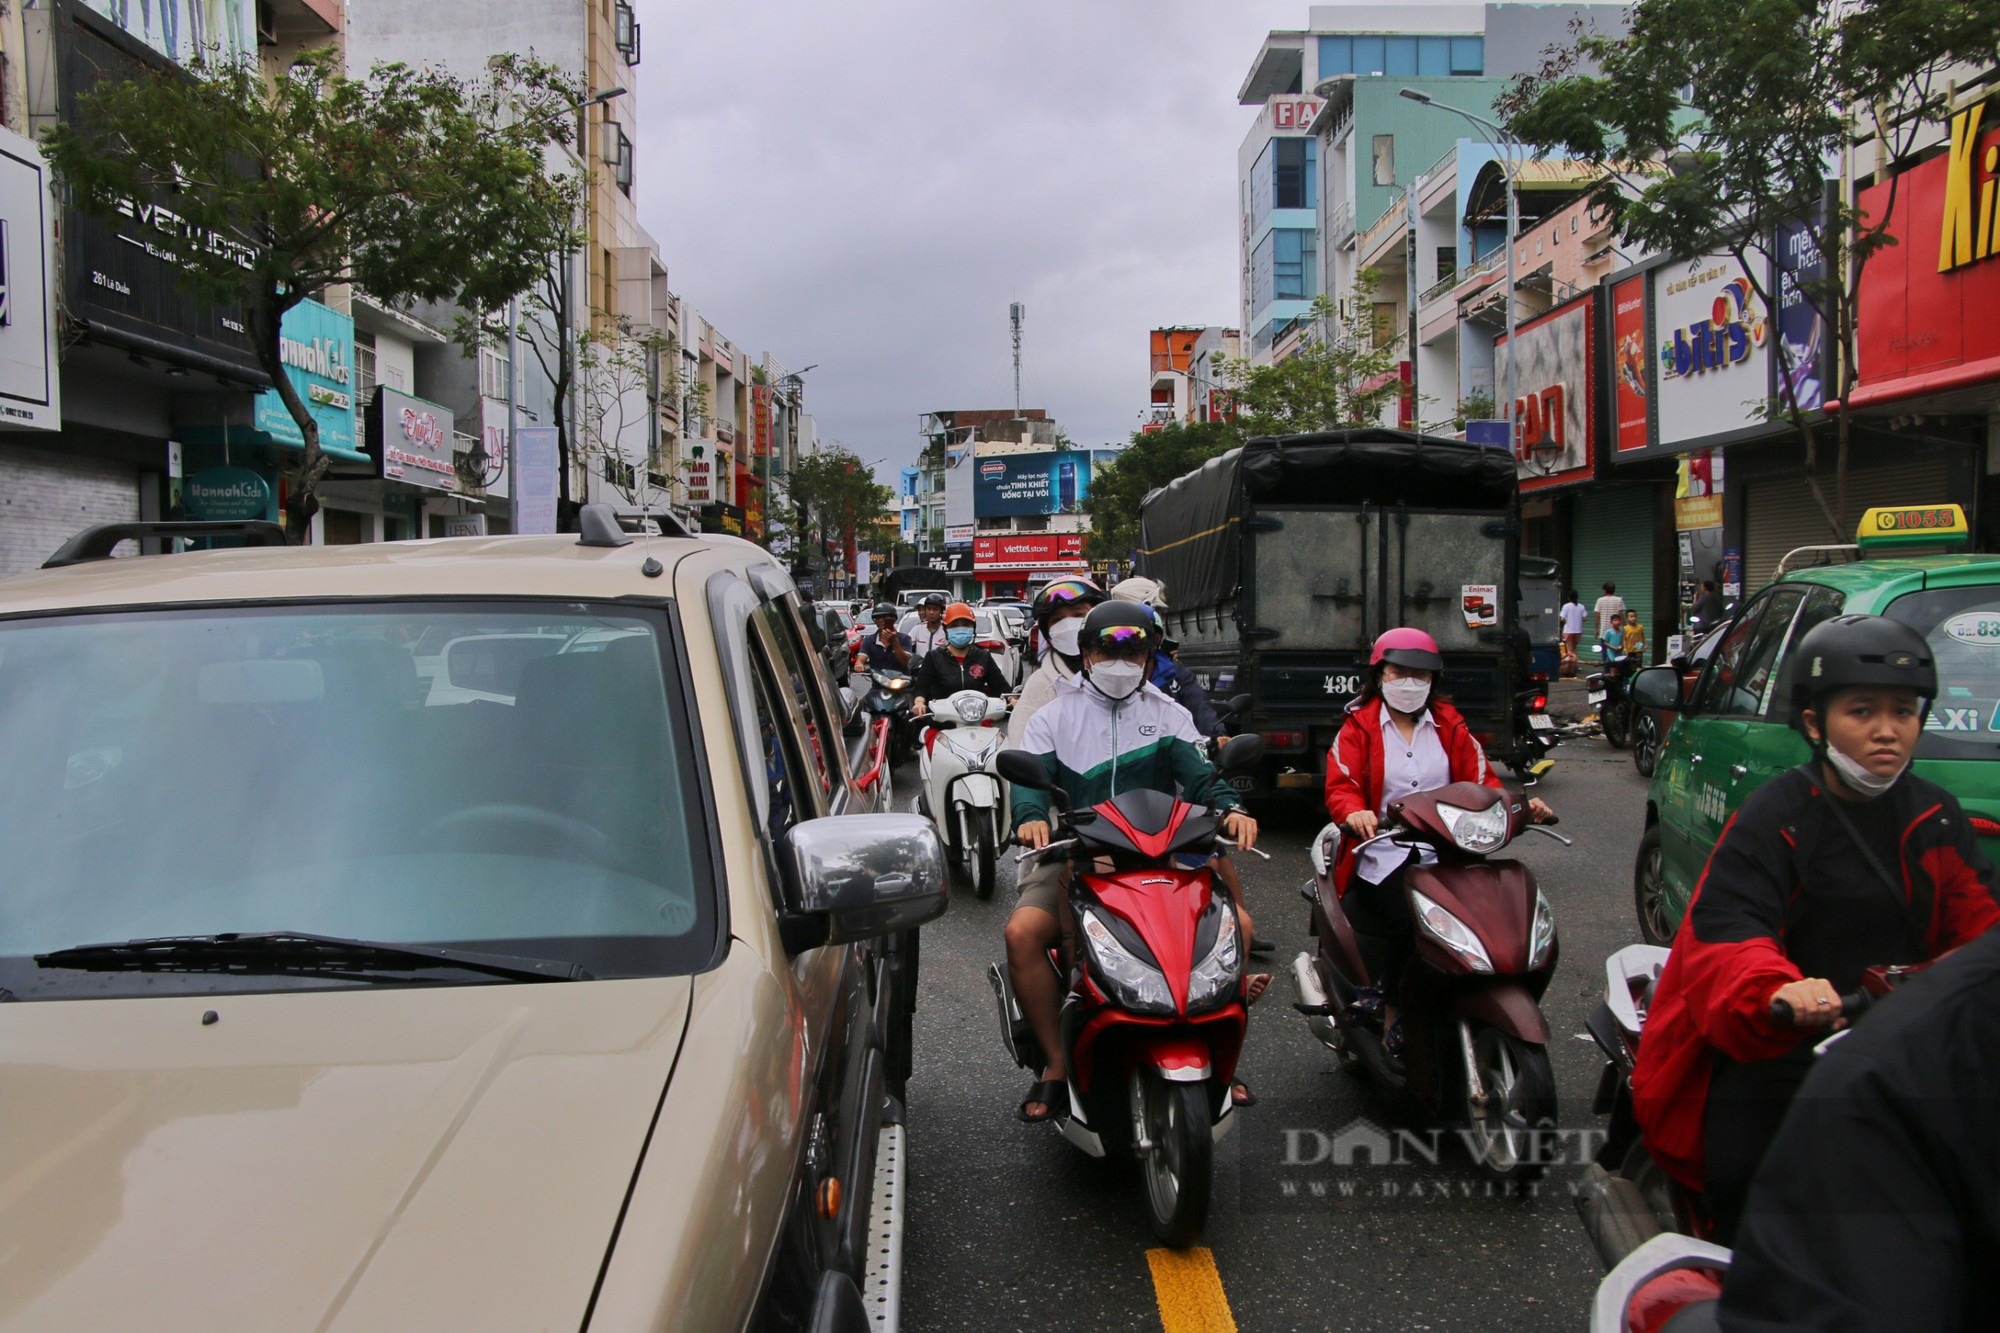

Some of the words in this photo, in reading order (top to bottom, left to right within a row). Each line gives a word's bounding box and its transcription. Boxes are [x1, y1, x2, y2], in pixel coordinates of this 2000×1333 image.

[1937, 102, 2000, 273] Ki
[92, 270, 107, 286] 261
[690, 475, 707, 486] KIM
[1011, 482, 1027, 490] TINH
[1028, 478, 1049, 488] KHIẾT
[1002, 490, 1021, 499] UỐNG
[1022, 491, 1034, 500] TẠI
[1036, 489, 1049, 497] VÒI
[1895, 510, 1953, 528] 1055
[449, 525, 479, 536] LEENA
[985, 550, 995, 558] GÓP
[1004, 545, 1030, 553] viettel
[1923, 709, 1979, 731] AXi
[1232, 778, 1253, 789] KIA
